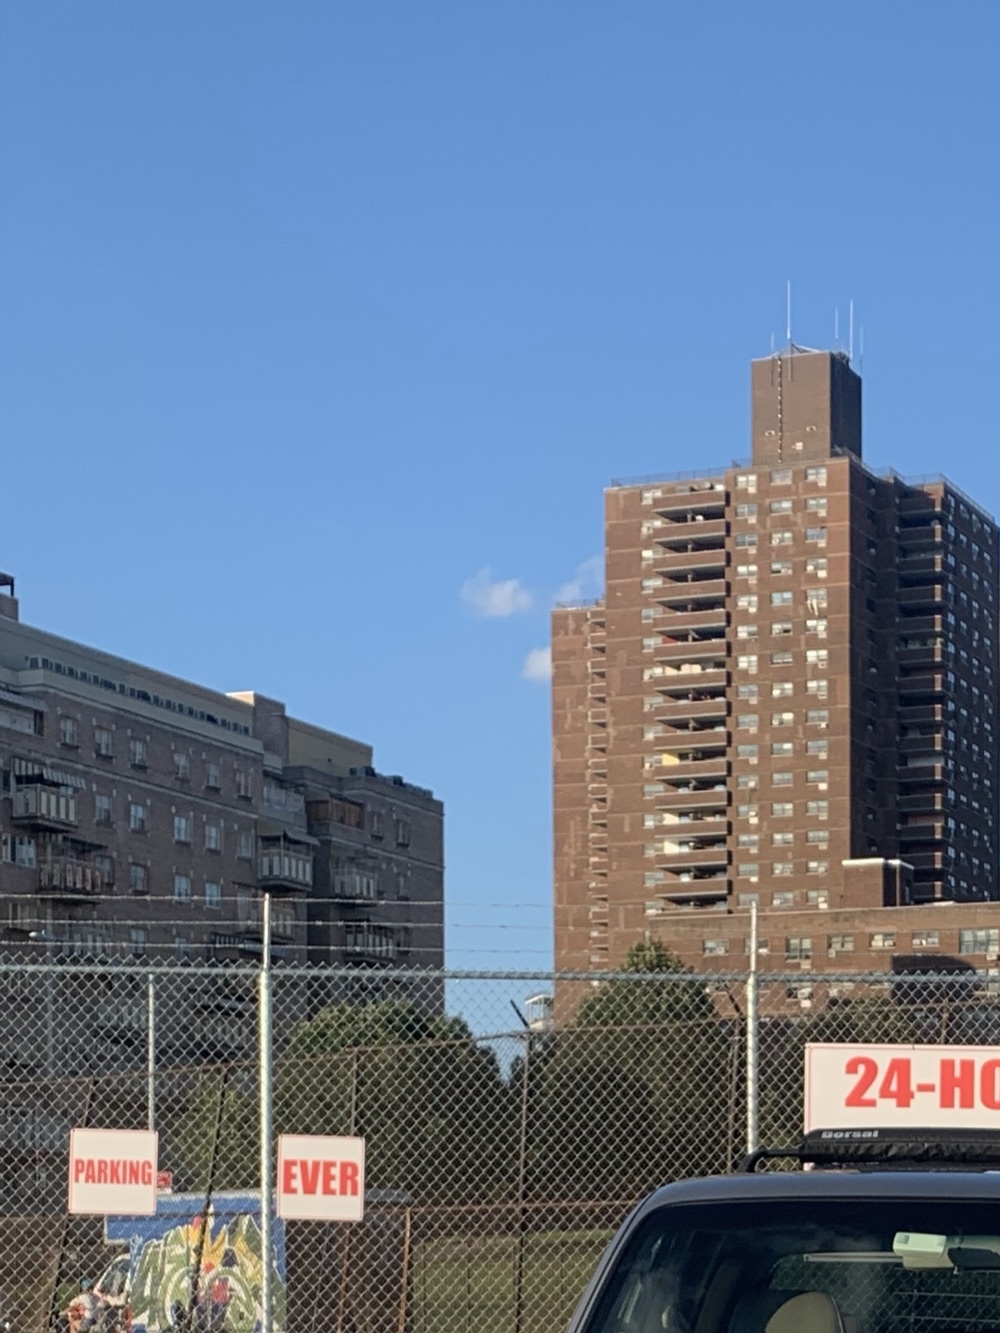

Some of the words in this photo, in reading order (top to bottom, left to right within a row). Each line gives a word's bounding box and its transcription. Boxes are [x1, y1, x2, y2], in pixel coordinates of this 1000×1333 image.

[821, 1130, 879, 1139] Dorsal
[74, 1158, 153, 1186] PARKING
[282, 1159, 359, 1196] EVER
